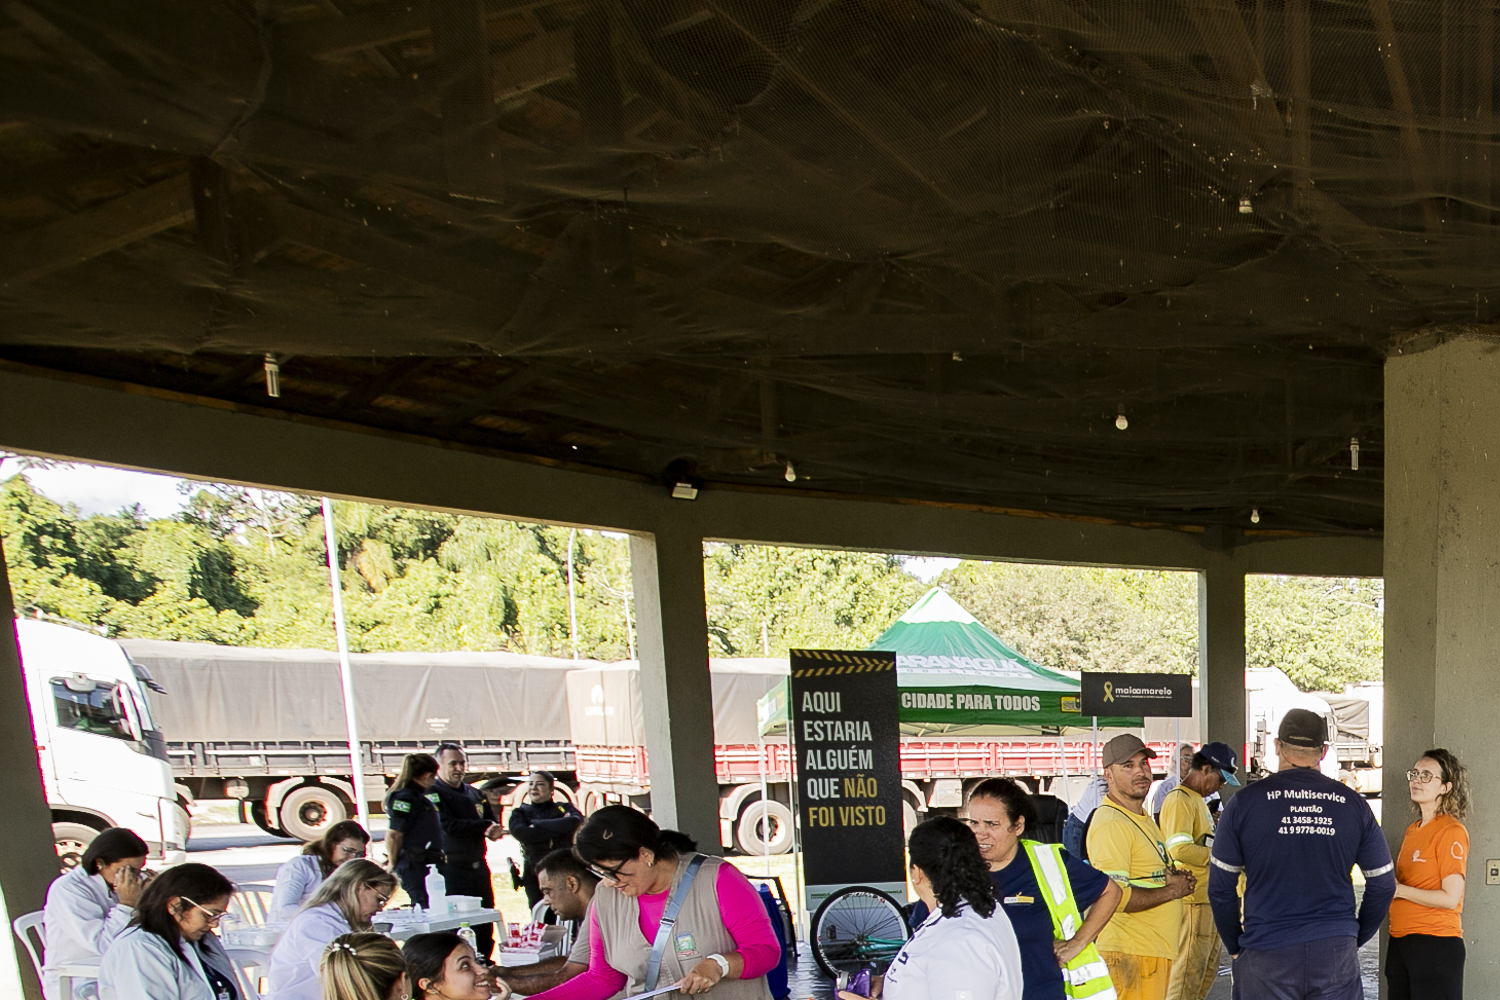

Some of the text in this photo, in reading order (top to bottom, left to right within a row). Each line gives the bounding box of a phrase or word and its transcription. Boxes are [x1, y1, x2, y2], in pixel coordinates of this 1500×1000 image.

[896, 655, 1029, 673] ARANAGUÁ
[802, 691, 841, 714] AQUI
[901, 692, 1041, 712] CIDADE PARA TODOS
[803, 720, 873, 742] ESTARIA
[805, 745, 873, 770] ALGUÉM
[807, 774, 877, 801] QUE NÃO
[1266, 789, 1346, 804] HP Multiservice
[808, 805, 886, 827] FOI VISTO
[1290, 805, 1323, 813] PLANTÃO
[1281, 816, 1333, 825] 41 3458-1925
[1278, 826, 1336, 836] 41 9 9778-0019
